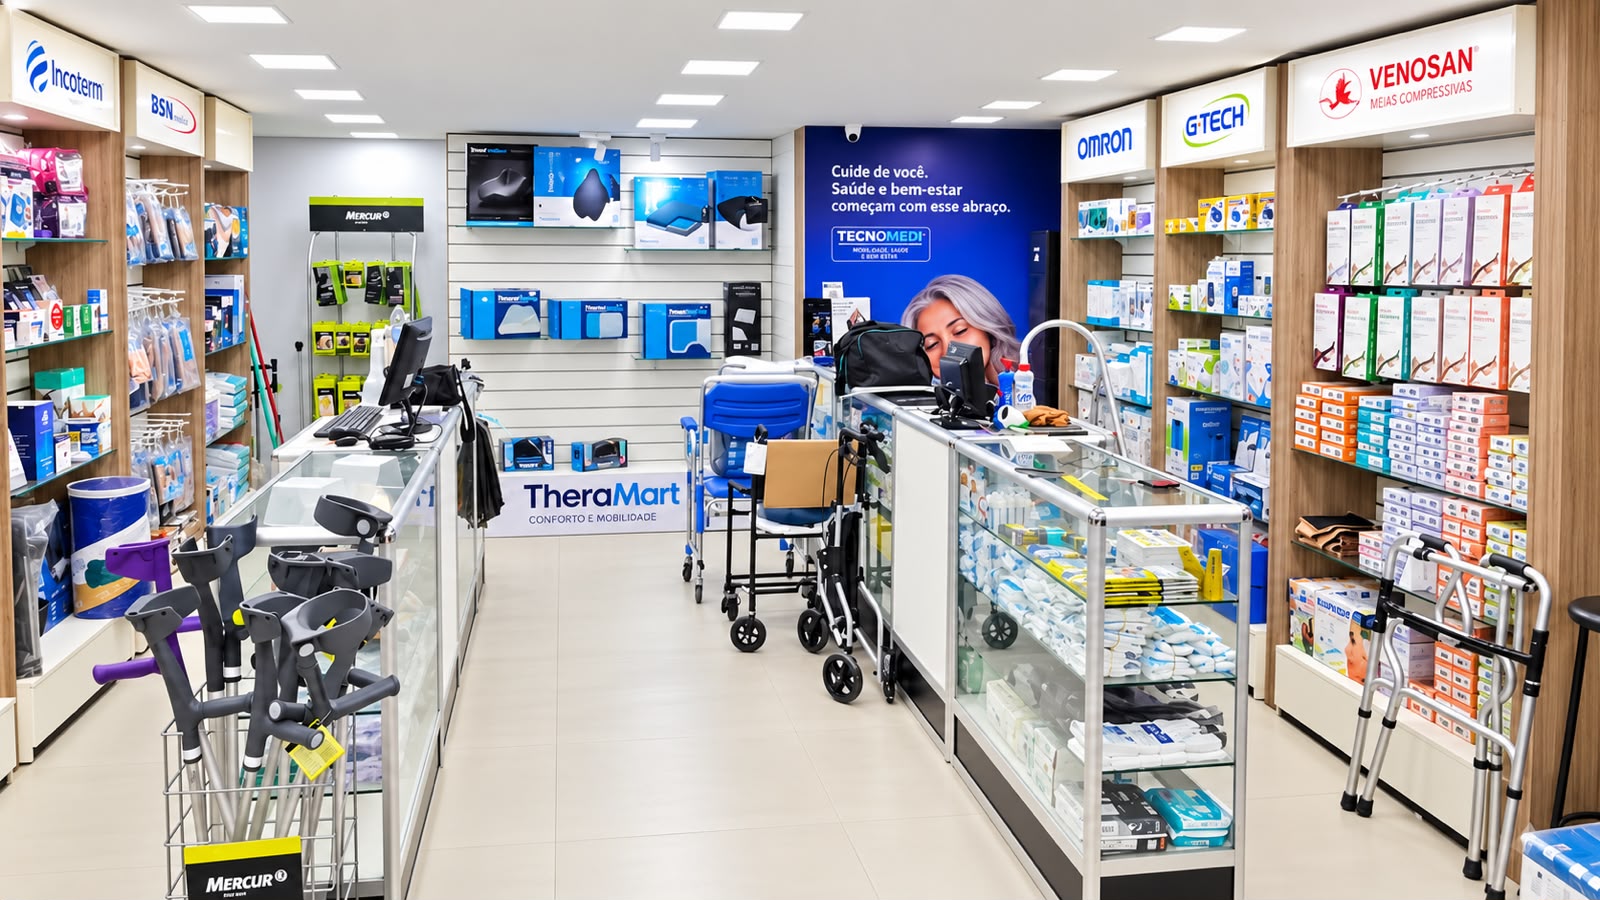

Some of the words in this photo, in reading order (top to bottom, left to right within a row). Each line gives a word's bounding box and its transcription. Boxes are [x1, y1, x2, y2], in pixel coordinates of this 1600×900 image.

[1369, 46, 1473, 90] VENOSAN
[51, 59, 103, 101] Incoterm
[1370, 93, 1397, 110] MEIAS
[1399, 79, 1473, 104] COMPRESSIVAS
[151, 93, 173, 120] BSN
[1077, 127, 1132, 160] OMRON
[831, 164, 870, 179] Cuide
[873, 164, 890, 179] de
[894, 165, 929, 179] você.
[831, 182, 875, 196] Saúde
[878, 185, 887, 196] e
[890, 182, 963, 196] bem-estar
[345, 211, 382, 220] MERCUR
[831, 201, 896, 215] começam
[899, 202, 927, 213] com
[930, 202, 959, 213] esse
[962, 200, 1011, 215] abraço.
[837, 230, 922, 242] TECNOMEDI
[523, 482, 681, 509] TheraMart
[529, 514, 585, 525] CONFORTO
[588, 514, 594, 523] E
[597, 512, 657, 522] MOBILIDADE
[205, 873, 274, 893] MERCUR
